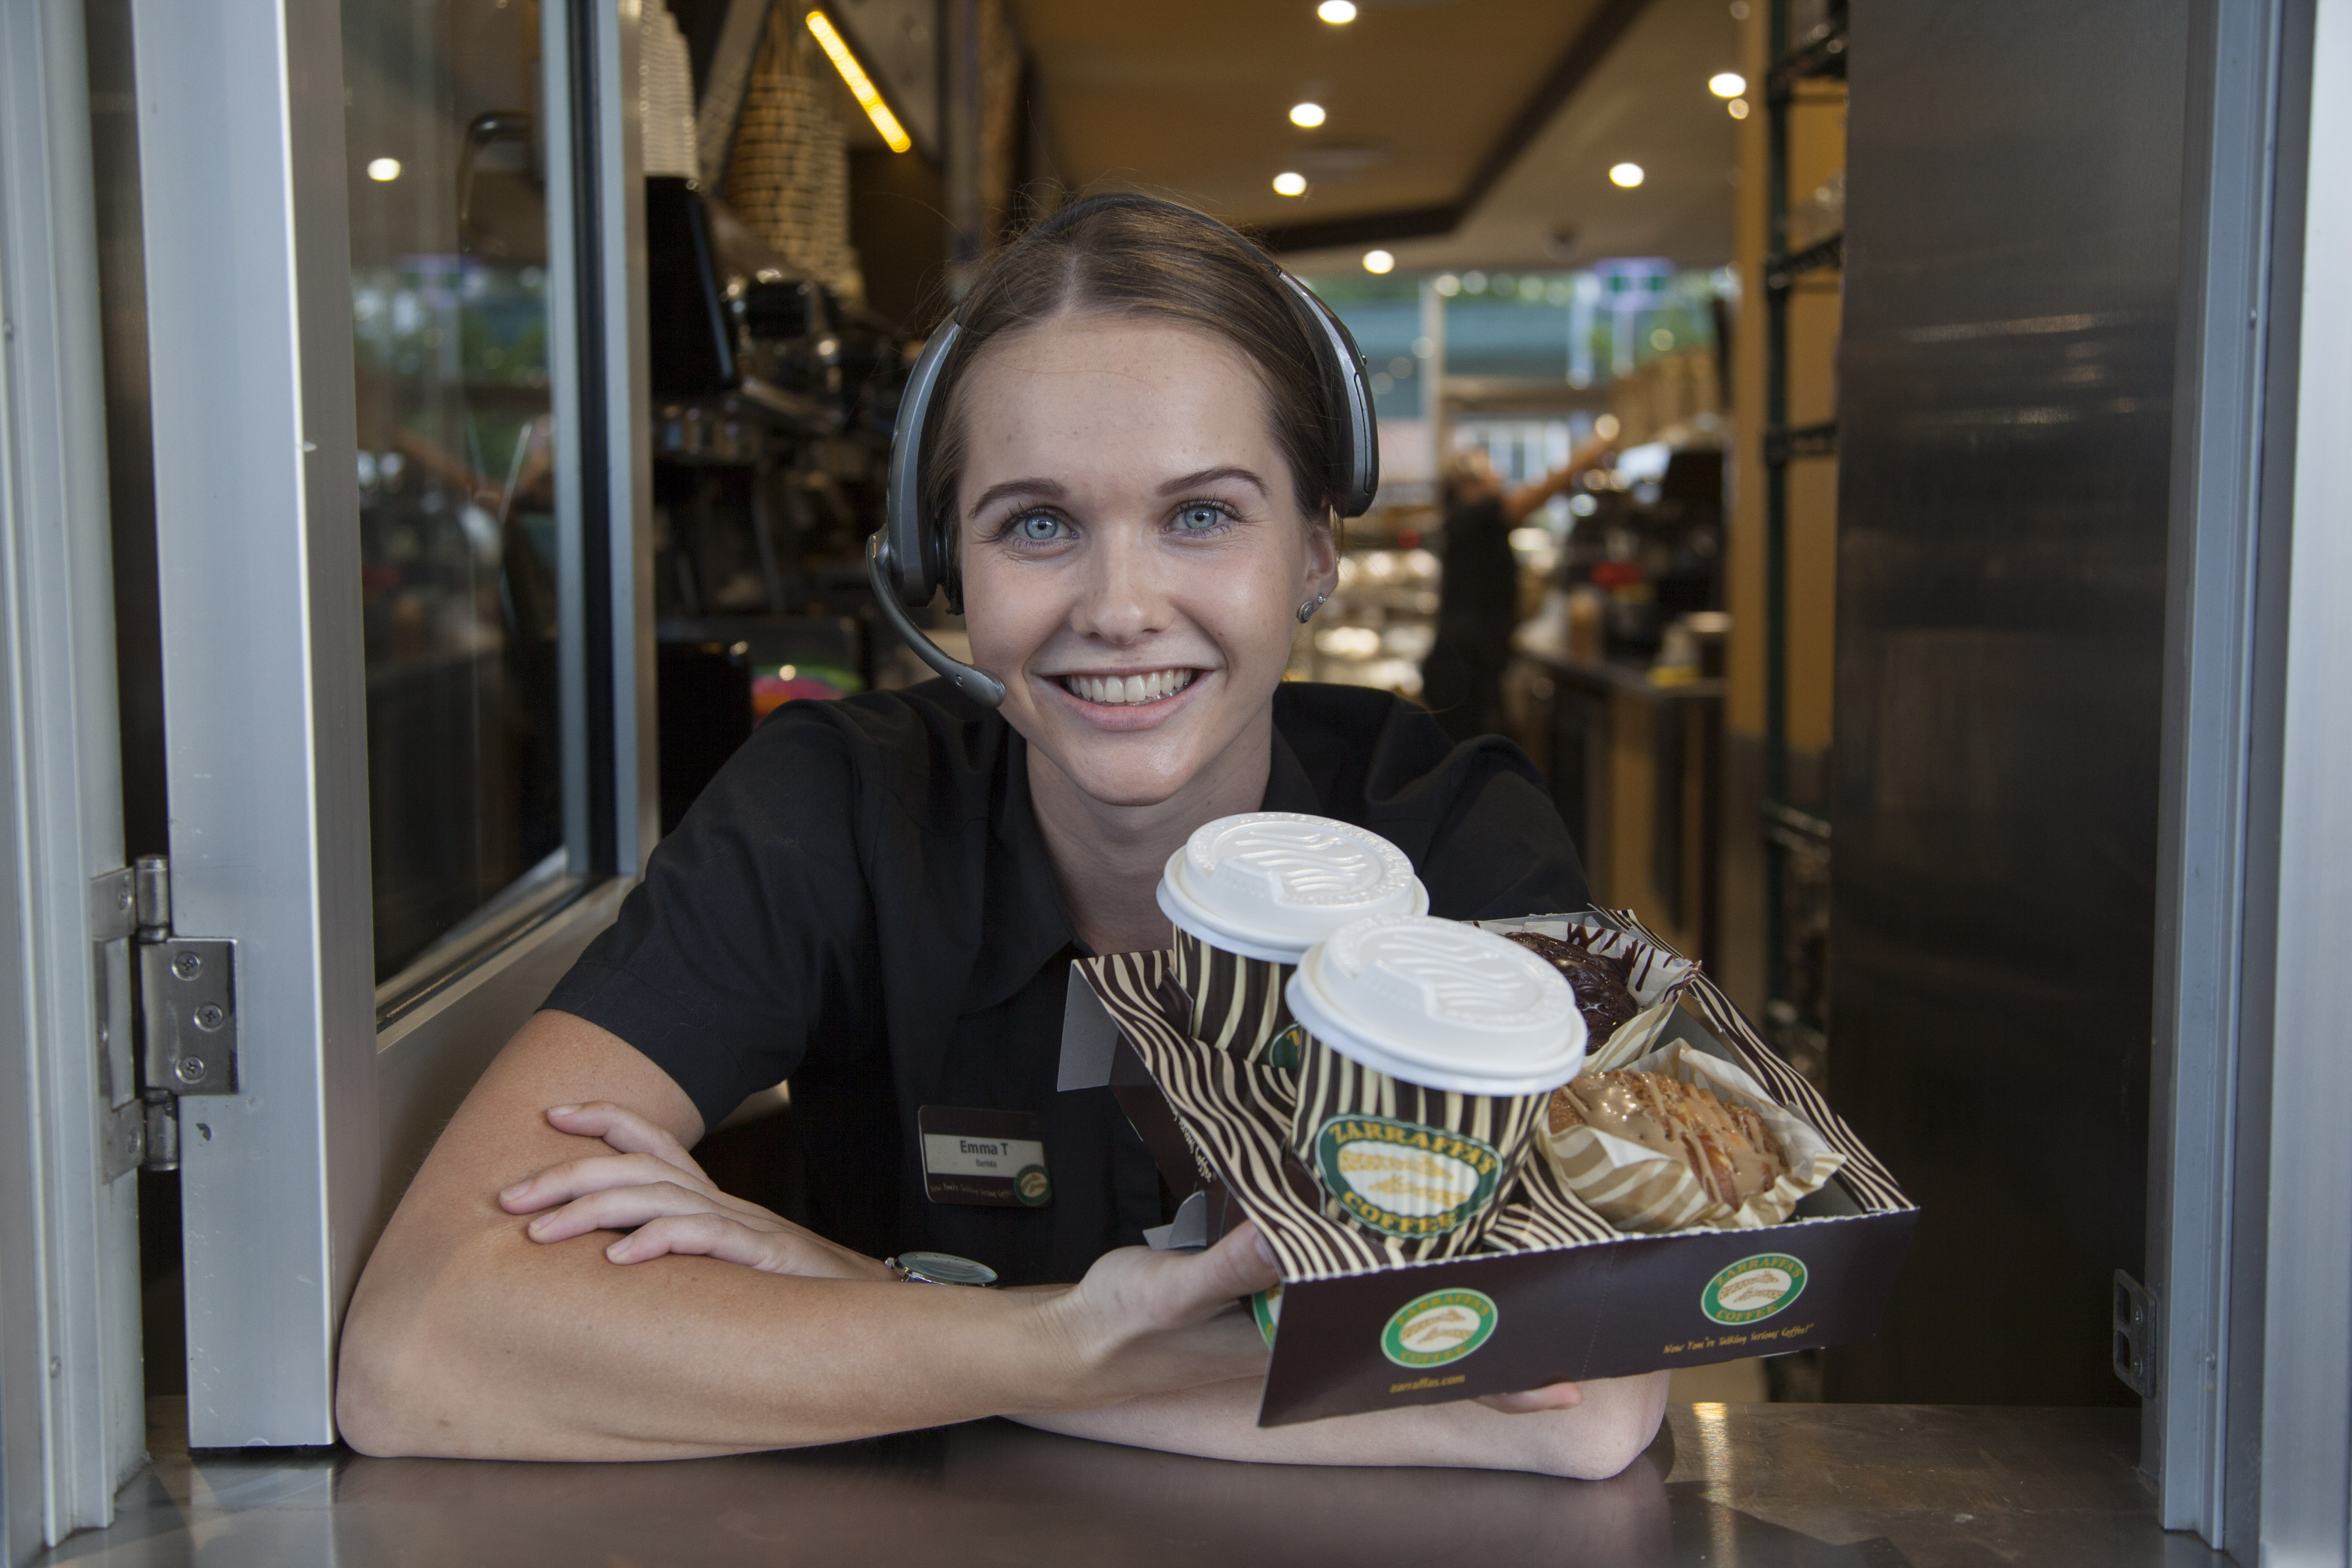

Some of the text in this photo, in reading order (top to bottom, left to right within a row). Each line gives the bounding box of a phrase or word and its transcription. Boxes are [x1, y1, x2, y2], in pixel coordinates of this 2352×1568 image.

[960, 1140, 1008, 1156] Emma T
[1343, 1190, 1457, 1233] COFFEE
[1718, 1303, 1777, 1320] COFFEE
[1663, 1344, 1685, 1354] Now
[1687, 1336, 1716, 1350] You're
[1719, 1334, 1747, 1346] Talking
[1751, 1330, 1779, 1341] Serious
[1400, 1345, 1468, 1364] COFFEE
